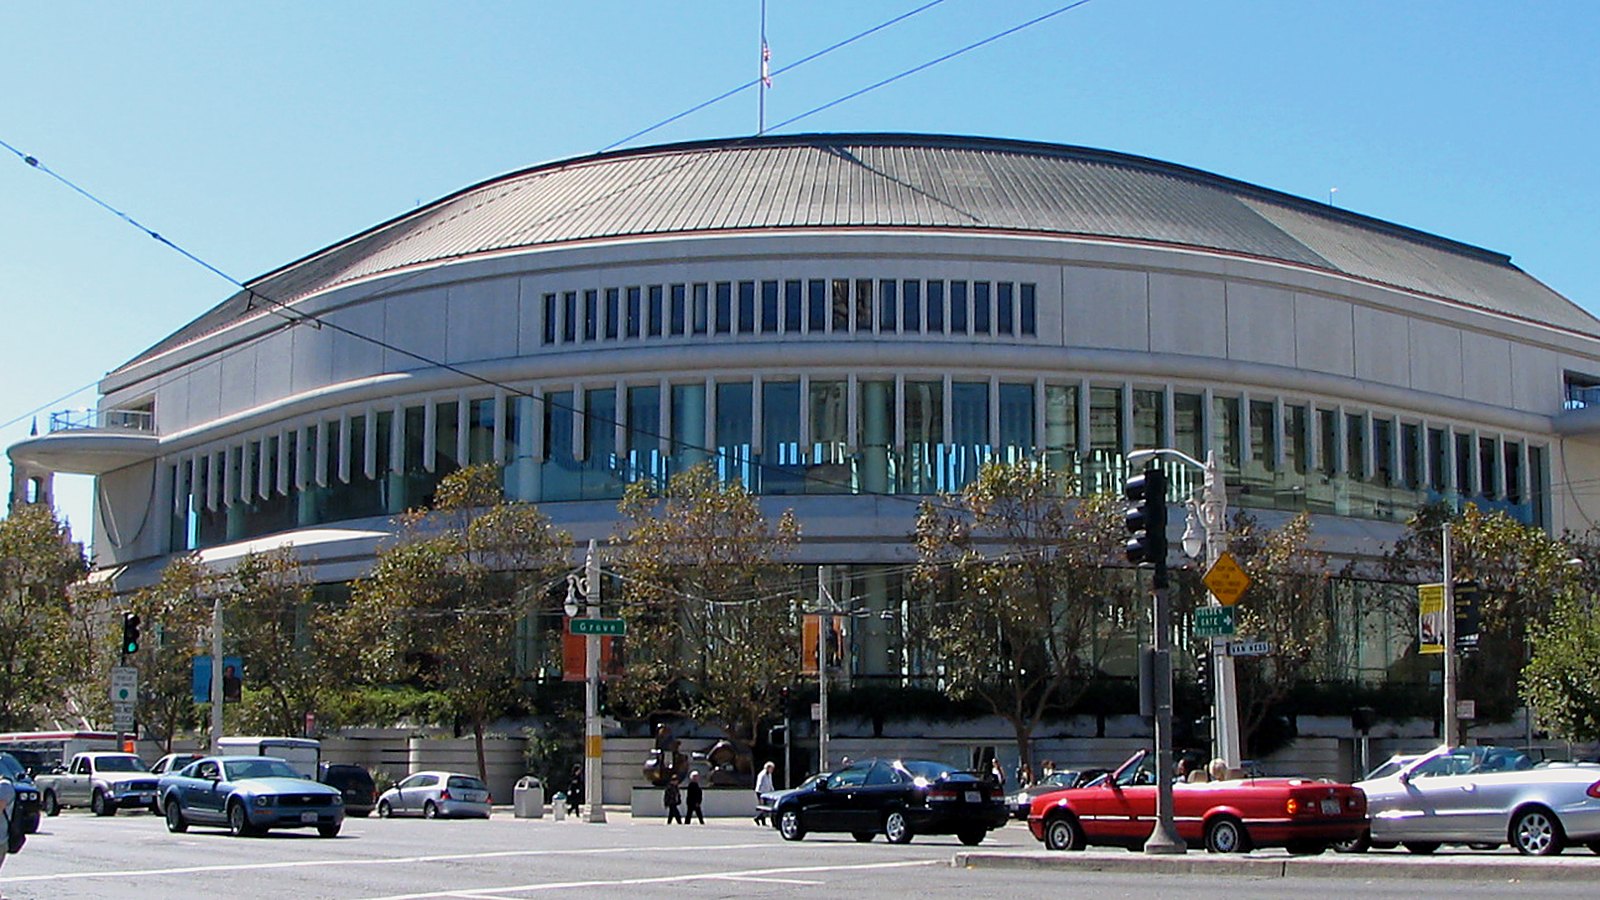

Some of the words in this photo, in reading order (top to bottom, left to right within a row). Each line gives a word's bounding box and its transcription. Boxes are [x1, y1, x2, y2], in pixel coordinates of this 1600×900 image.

[1201, 617, 1218, 626] GATE
[580, 622, 616, 632] Grove
[1232, 645, 1246, 653] VAN
[1249, 643, 1267, 651] NESS
